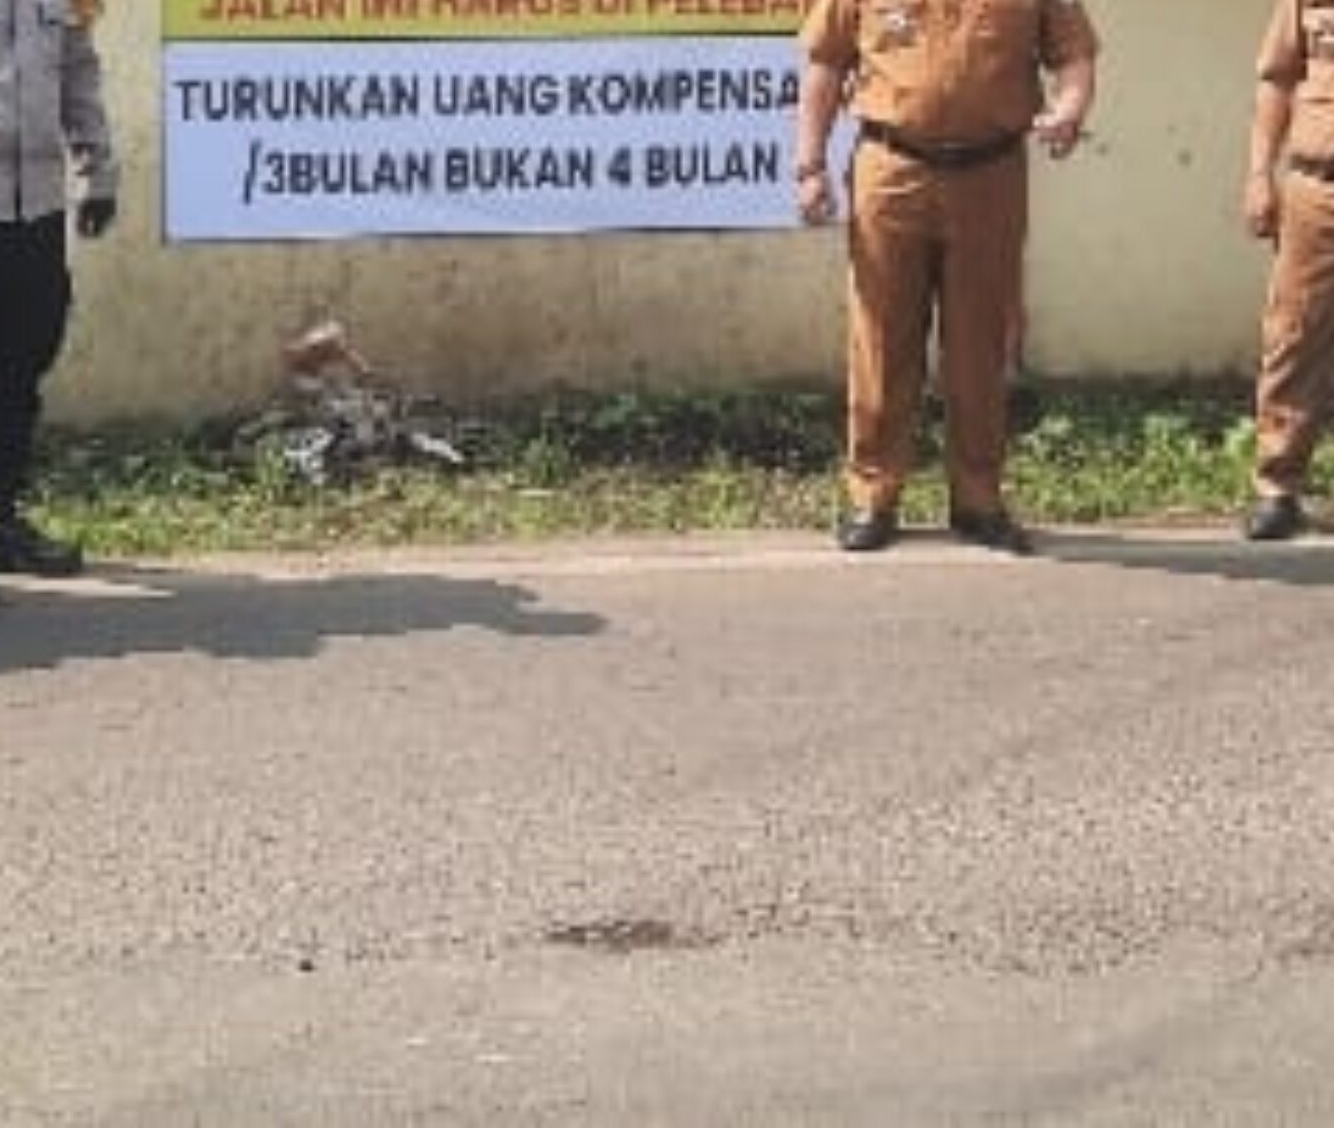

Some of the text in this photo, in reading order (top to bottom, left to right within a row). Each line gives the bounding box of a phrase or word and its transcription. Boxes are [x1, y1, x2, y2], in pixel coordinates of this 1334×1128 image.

[174, 68, 801, 122] TURUNKAN UANG KOMPENSA
[241, 137, 779, 206] /3BULAN BUKAN 4 BULAN
